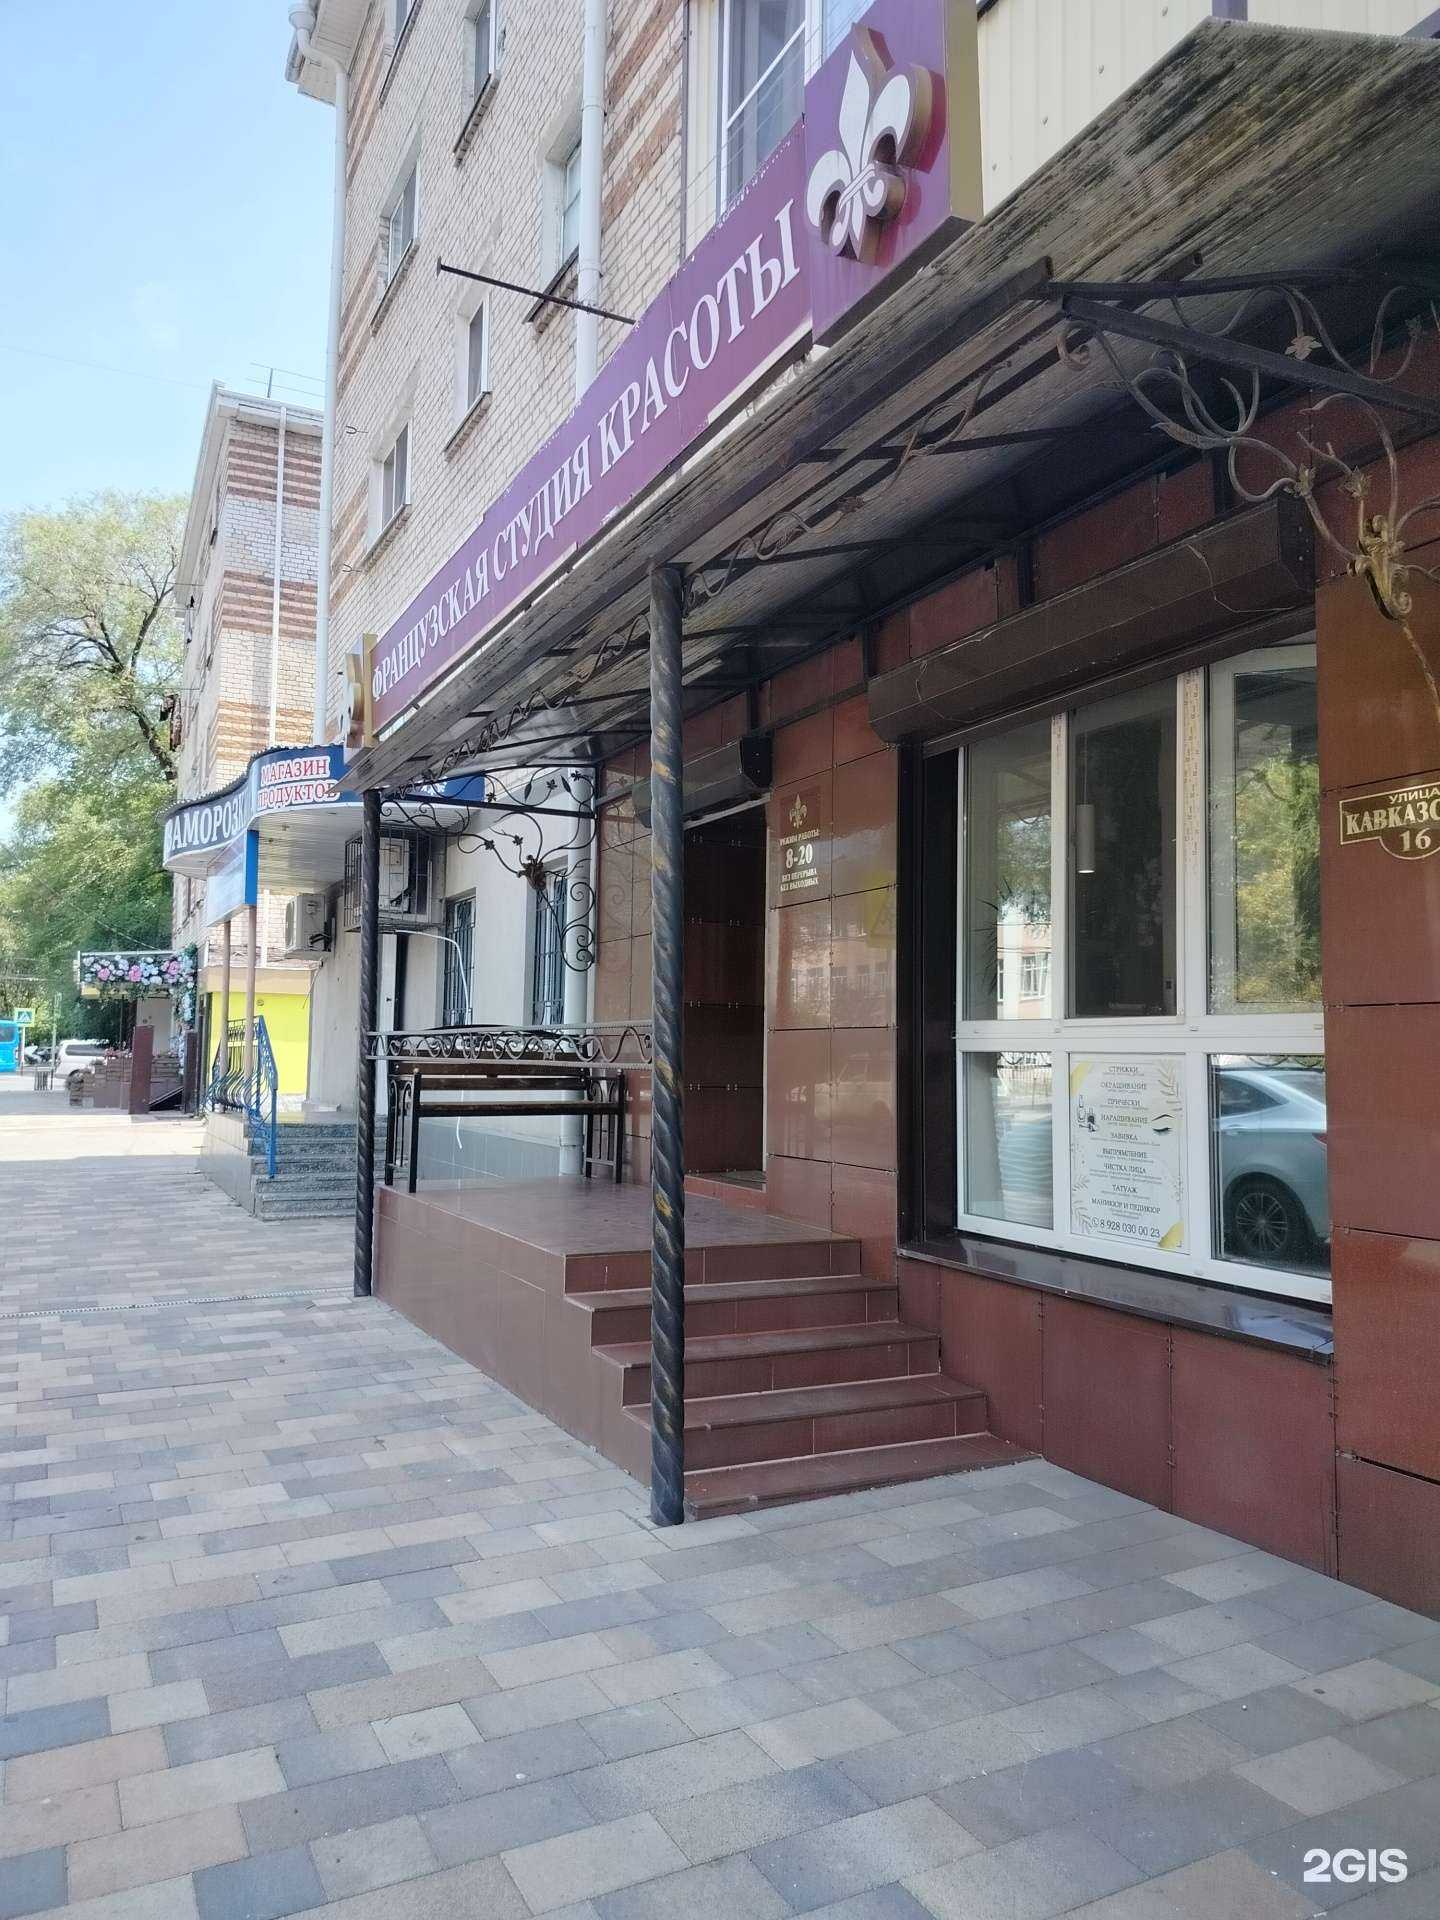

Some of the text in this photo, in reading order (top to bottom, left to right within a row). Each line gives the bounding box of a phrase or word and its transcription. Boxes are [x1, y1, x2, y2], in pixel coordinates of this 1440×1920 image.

[372, 198, 801, 702] ФРАНЦУЗСКАЯ СТУДИЯ КРАСОТЫ
[262, 759, 327, 784] МАГАЗИН
[1389, 787, 1440, 804] УЛИЦА
[1400, 827, 1431, 851] 16
[785, 843, 813, 869] 8-20
[1112, 1185, 1138, 1193] ТАТУАЖ
[1100, 1219, 1160, 1238] 8 928 030 00 23
